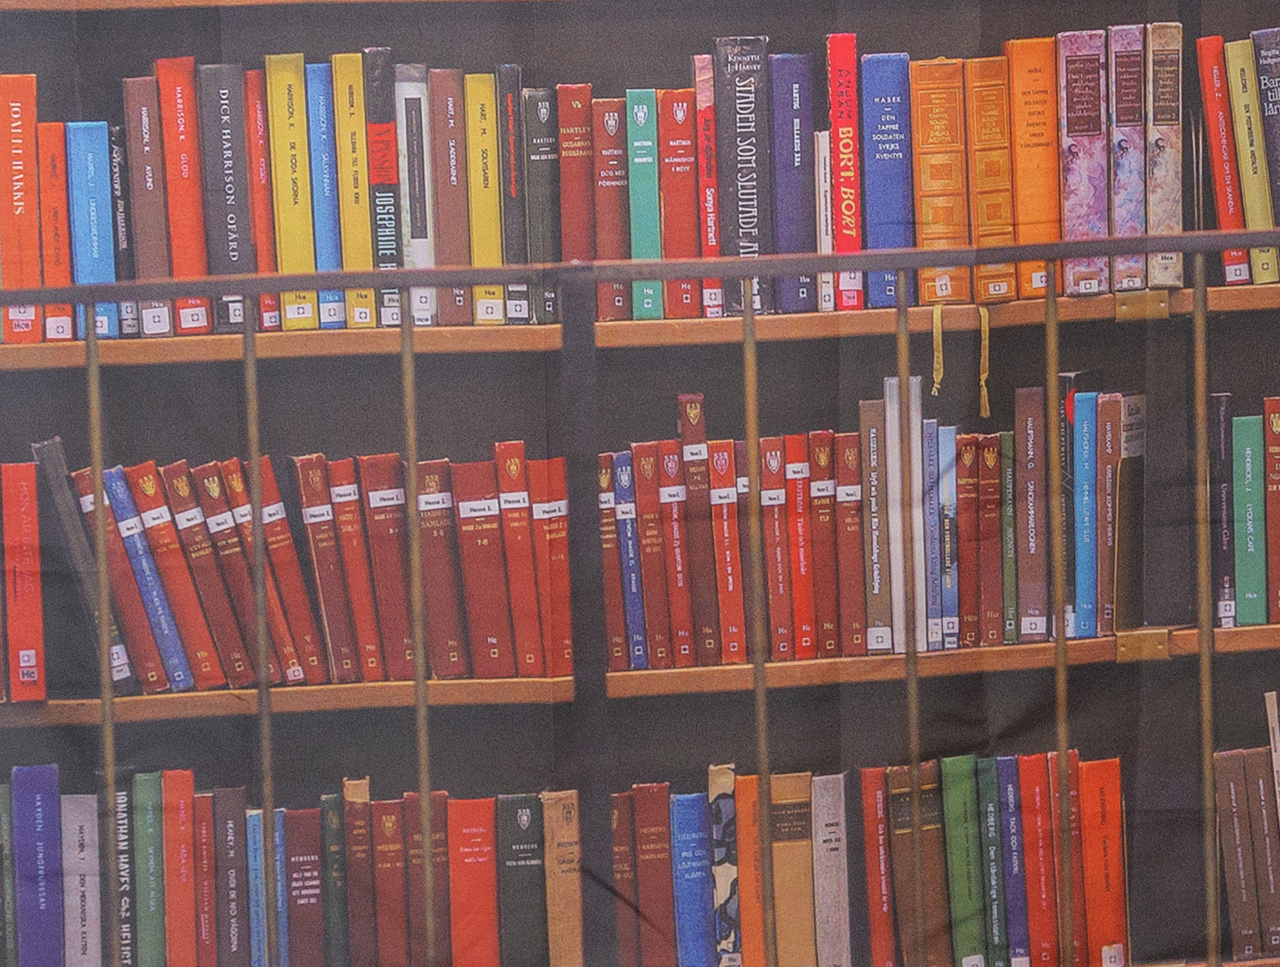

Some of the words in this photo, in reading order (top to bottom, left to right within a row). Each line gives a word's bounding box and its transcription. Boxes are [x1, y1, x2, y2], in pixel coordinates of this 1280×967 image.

[219, 89, 231, 124] DICK
[735, 76, 756, 132] STADEN
[221, 129, 236, 206] HARRISON
[481, 148, 490, 189] SOLVISAREN
[736, 137, 756, 168] SOM
[838, 127, 854, 182] BORT,
[704, 187, 716, 213] Sonya
[735, 172, 758, 237] SLUTADE
[841, 187, 856, 237] BORT
[226, 214, 240, 261] OFÄRD
[374, 191, 398, 256] JOSEPHINE
[706, 213, 717, 246] Hartnett
[35, 794, 43, 831] HAYDEN
[987, 803, 996, 837] HEDBERG
[988, 846, 997, 860] Den
